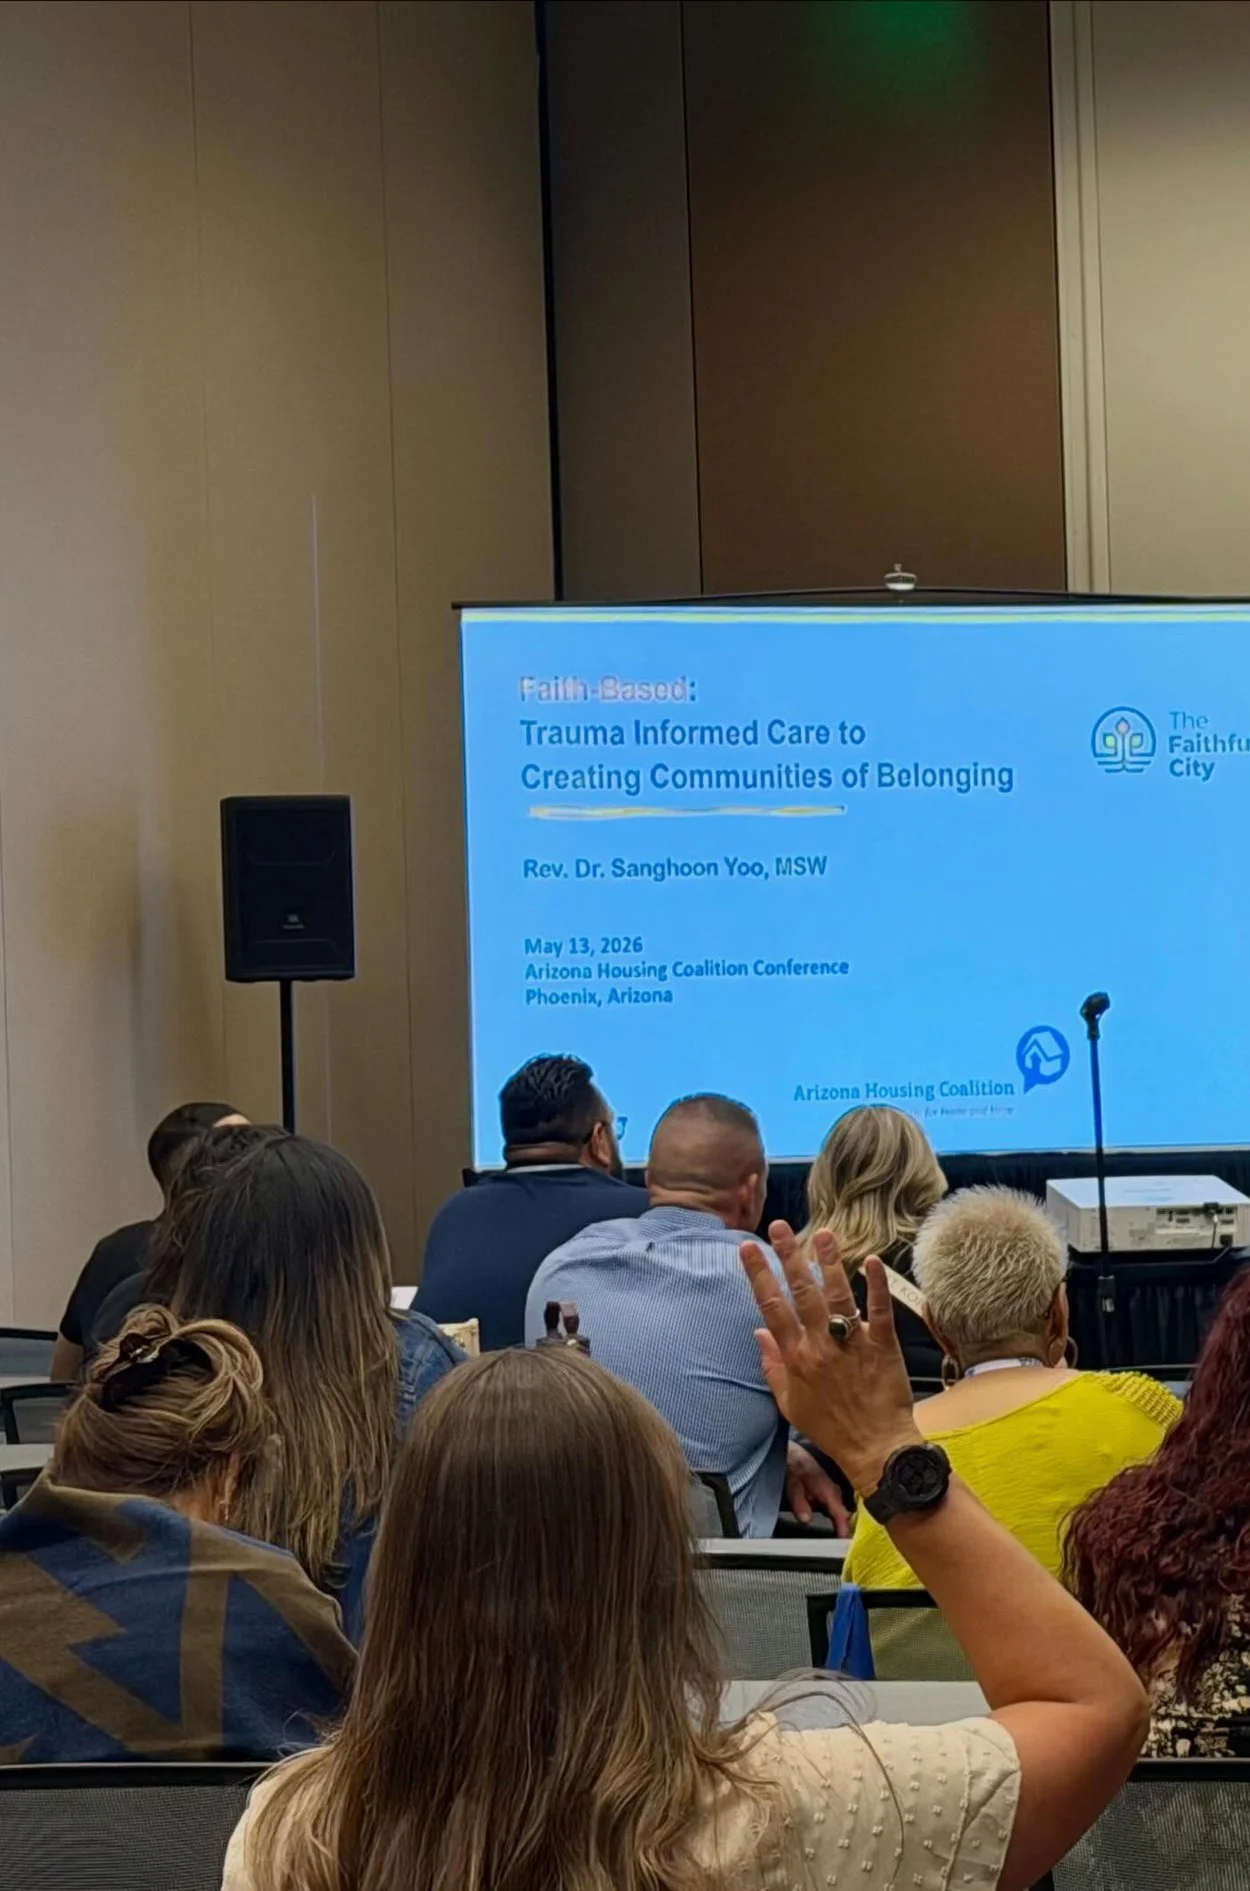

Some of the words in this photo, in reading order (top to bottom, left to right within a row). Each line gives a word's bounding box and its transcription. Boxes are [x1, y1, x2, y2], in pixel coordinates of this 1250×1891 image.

[520, 675, 697, 702] Faith-Based:
[519, 719, 625, 746] Trauma
[634, 718, 758, 746] Informed
[767, 718, 831, 746] Care
[838, 720, 866, 745] to
[1169, 711, 1209, 730] The
[521, 763, 641, 797] Creating
[650, 762, 833, 789] Communities
[841, 762, 871, 789] of
[877, 761, 1014, 793] Belonging
[1168, 757, 1215, 782] City
[523, 858, 568, 879] Rev.
[575, 858, 605, 879] Dr.
[611, 857, 719, 882] Sanghoon
[724, 856, 770, 880] Yoo,
[775, 855, 828, 877] MSW
[524, 937, 563, 958] May
[569, 936, 595, 957] 13,
[600, 935, 643, 954] 2026
[525, 962, 593, 980] Arizona
[597, 961, 668, 982] Housing
[672, 959, 749, 978] Coalition
[752, 958, 850, 976] Conference
[525, 987, 602, 1008] Phoenix,
[607, 986, 673, 1004] Arizona
[794, 1084, 860, 1101] Arizona
[865, 1082, 935, 1101] Housing
[939, 1079, 1015, 1098] Coalition
